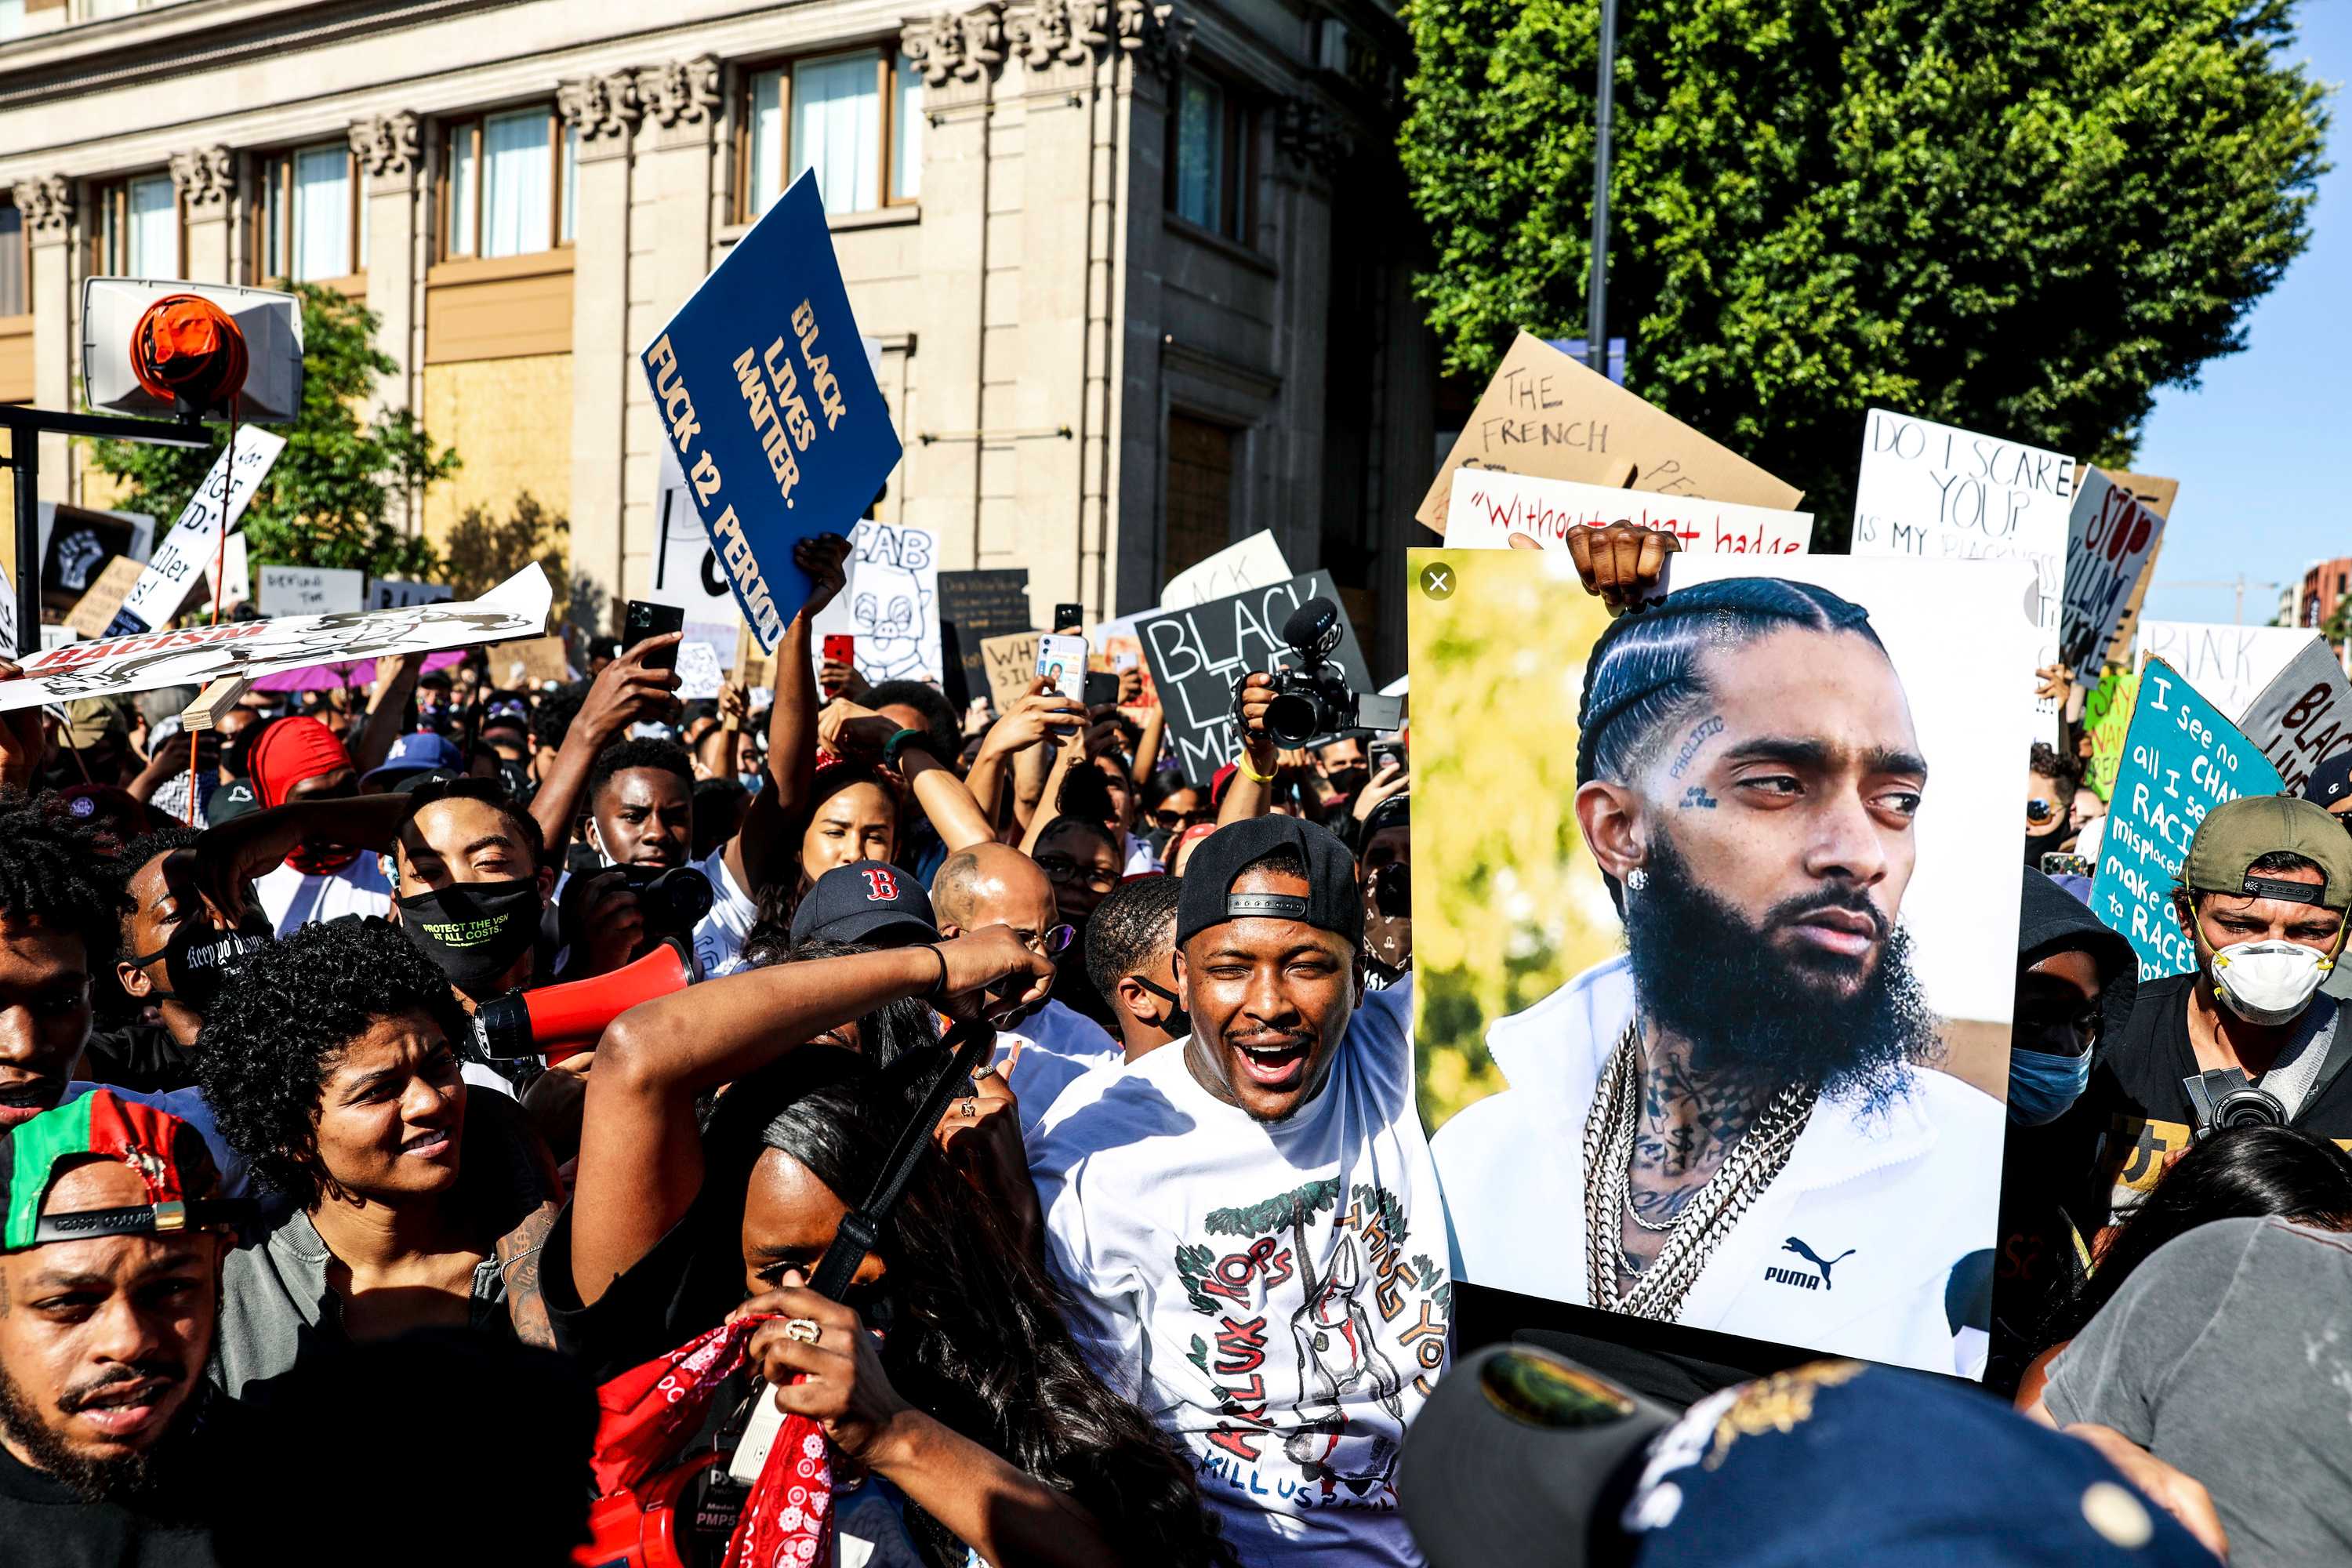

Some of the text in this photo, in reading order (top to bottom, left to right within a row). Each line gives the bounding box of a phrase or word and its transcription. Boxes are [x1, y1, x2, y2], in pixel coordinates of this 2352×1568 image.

[792, 297, 847, 430] BLACK
[1504, 367, 1563, 410] THE
[764, 336, 815, 452] LIVES
[733, 347, 800, 509] MATTER.
[1481, 416, 1608, 454] FRENCH
[1875, 415, 2073, 497] DO I SCARE
[648, 334, 702, 453] FUCK
[691, 450, 721, 506] 12
[713, 503, 786, 653] PERIOD
[1929, 470, 2031, 539] YOU?
[1858, 514, 1881, 543] IS
[1893, 521, 1928, 555] MY
[2085, 484, 2152, 577] STOP
[31, 626, 268, 667] RACISM
[2095, 680, 2133, 723] SAY
[2151, 677, 2238, 772] I see no
[2133, 745, 2160, 780] all
[2164, 768, 2181, 799] I
[2185, 794, 2207, 826] se
[2113, 815, 2183, 877] misplaced
[2132, 782, 2194, 856] RACI
[861, 868, 900, 902] B
[2105, 855, 2160, 911] make
[2107, 891, 2124, 918] to
[423, 913, 509, 932] PROTECT THE VSN
[445, 932, 464, 942] ALL
[465, 925, 503, 940] COSTS.
[187, 946, 216, 969] Keep
[1764, 1267, 1820, 1290] PUMA
[1200, 1448, 1269, 1494] KILL
[1278, 1478, 1313, 1508] US
[696, 1512, 740, 1526] PMP5
